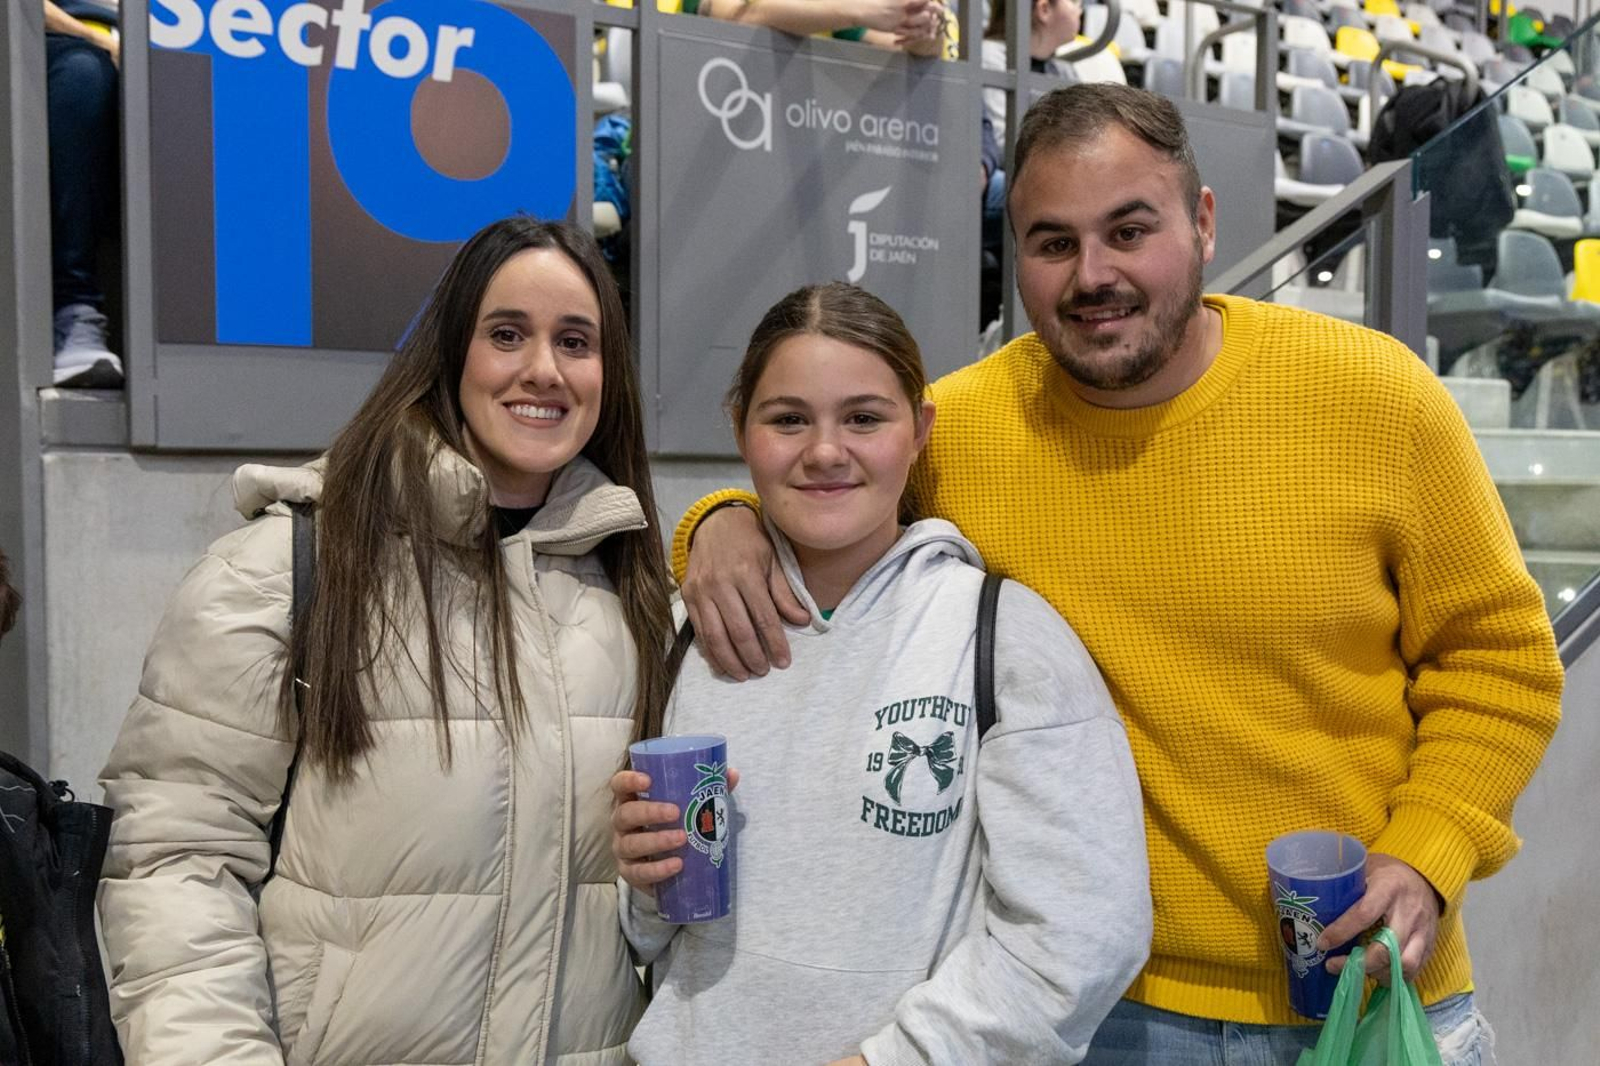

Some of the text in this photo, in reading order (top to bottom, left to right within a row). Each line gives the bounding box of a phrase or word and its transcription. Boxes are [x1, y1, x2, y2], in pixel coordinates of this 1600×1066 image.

[150, 0, 475, 82] Sector
[785, 99, 939, 146] olivo arena
[869, 248, 886, 262] DE
[874, 695, 971, 731] YOUTHFU
[866, 752, 884, 772] 19
[860, 795, 963, 837] FREEDOM
